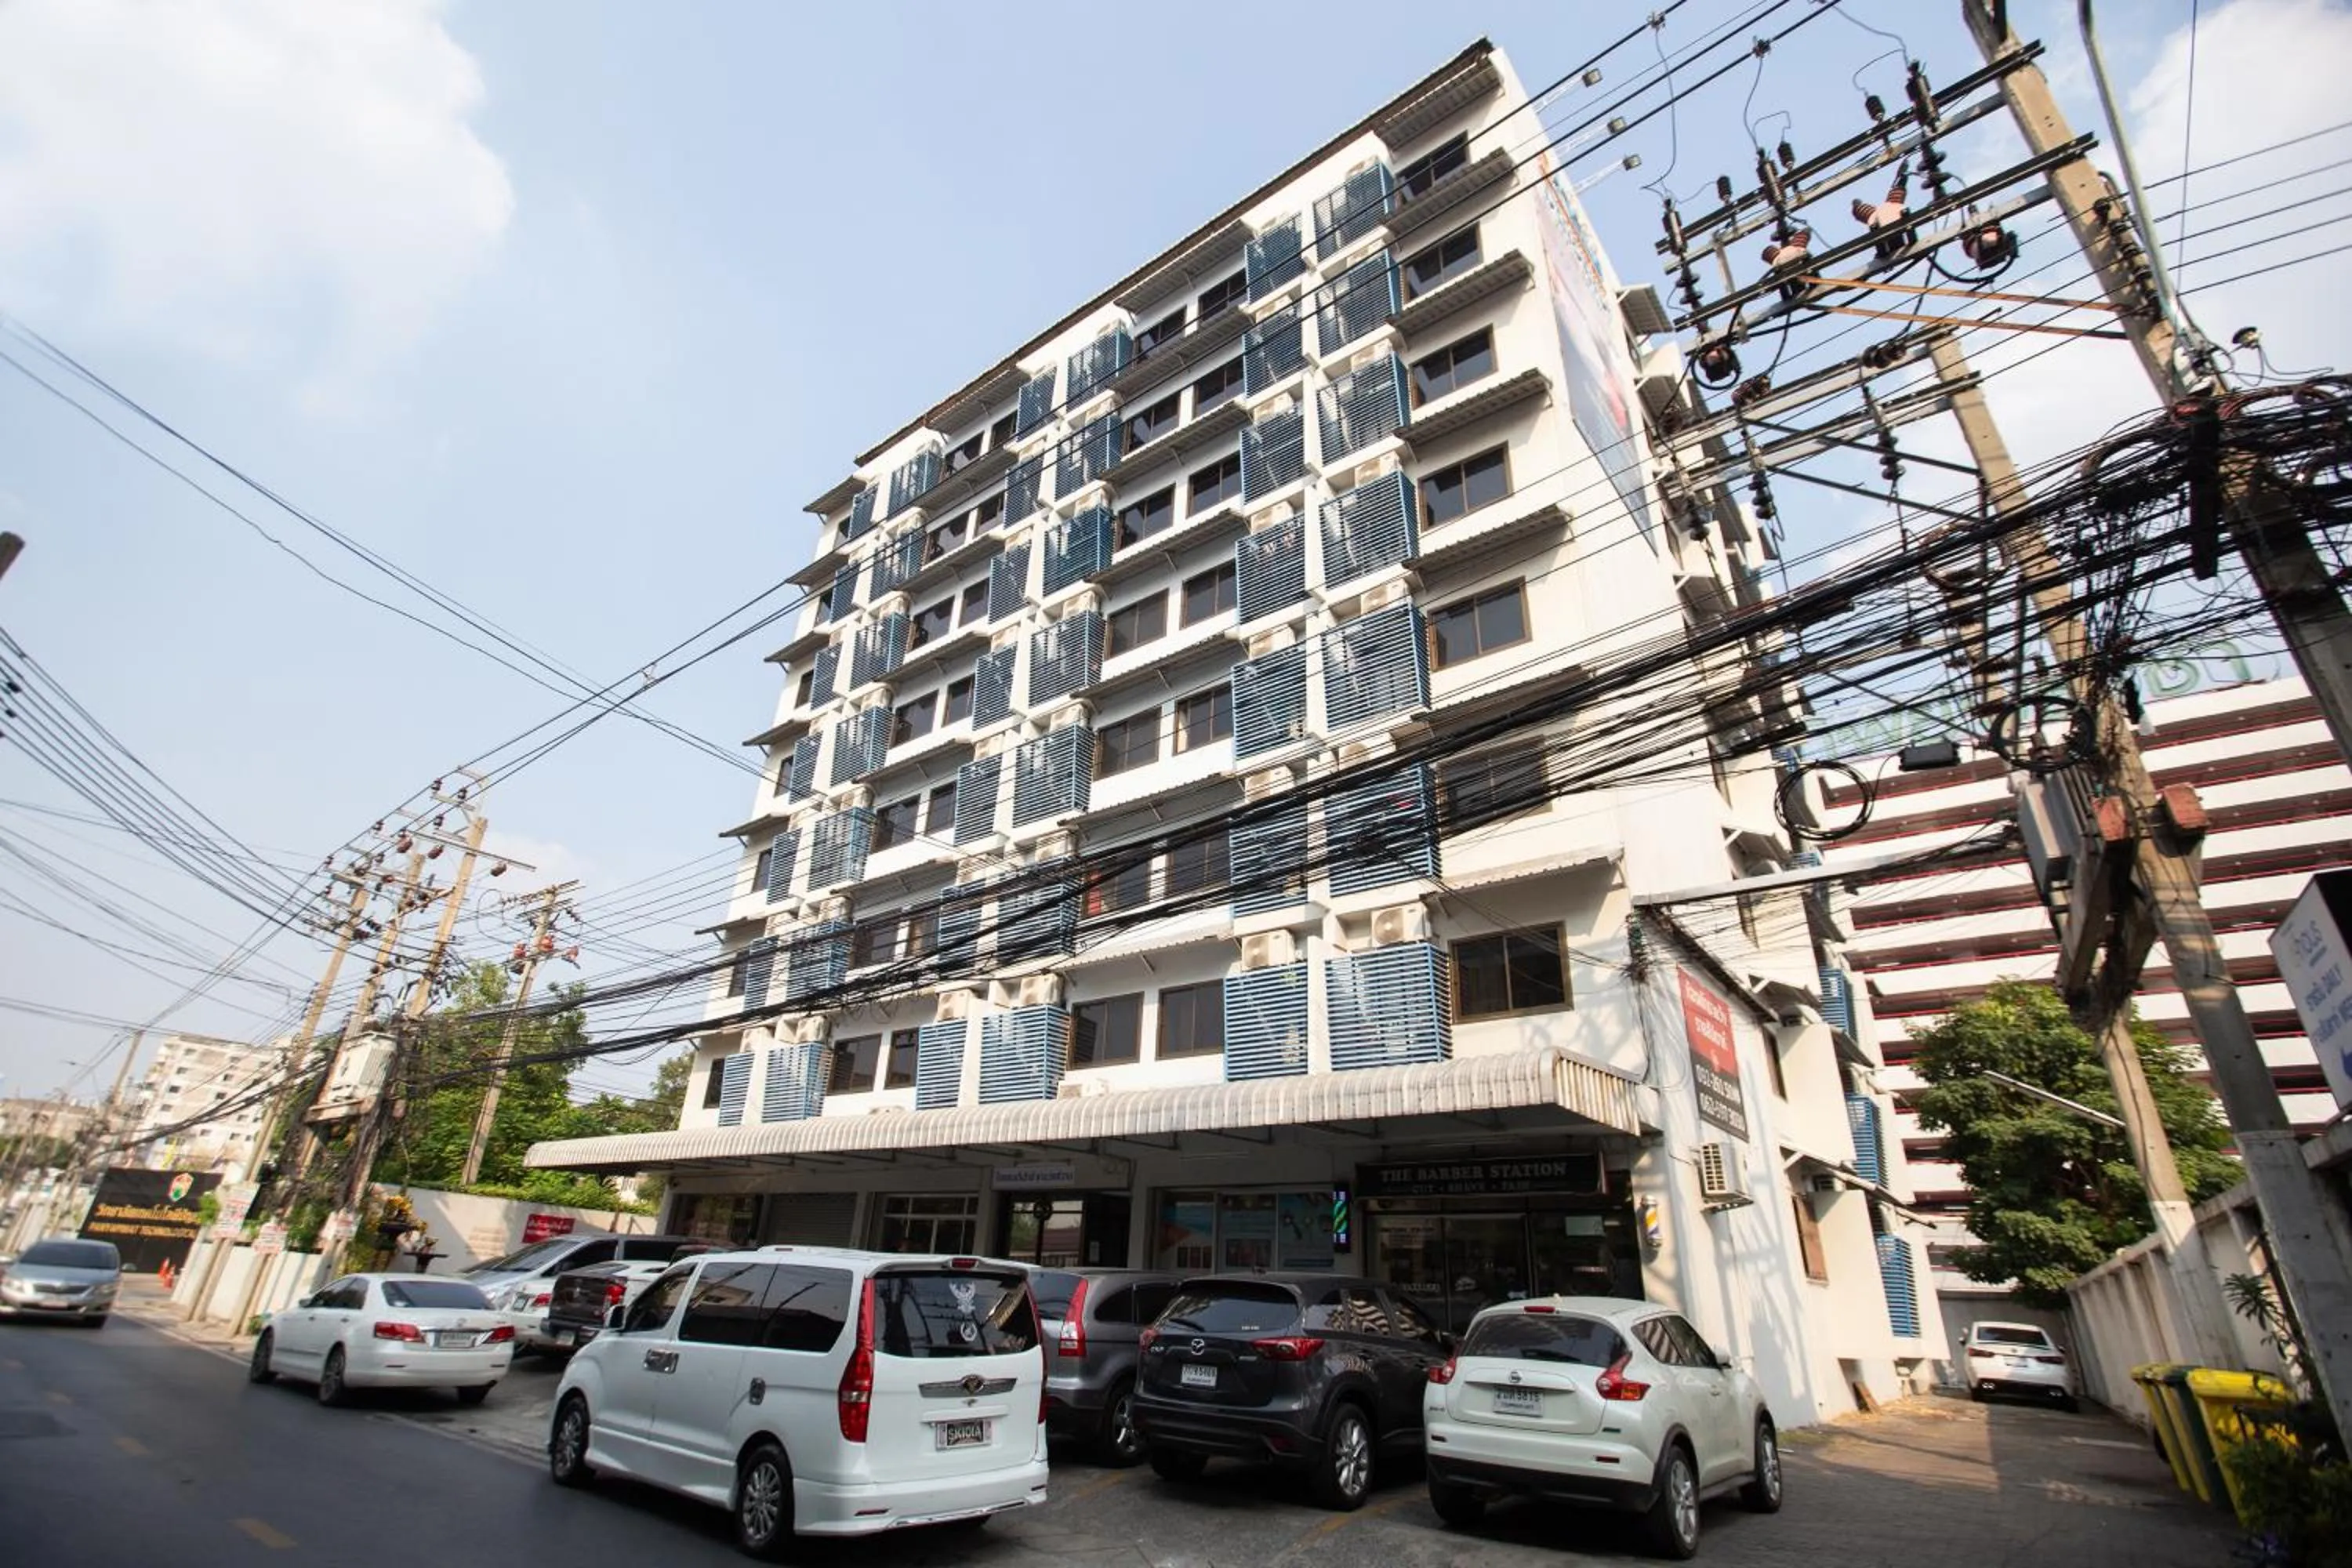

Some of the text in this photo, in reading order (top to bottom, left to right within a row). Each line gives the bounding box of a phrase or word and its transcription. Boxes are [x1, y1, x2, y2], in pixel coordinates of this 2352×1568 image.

[1380, 1162, 1567, 1181] THE BARBER STATION
